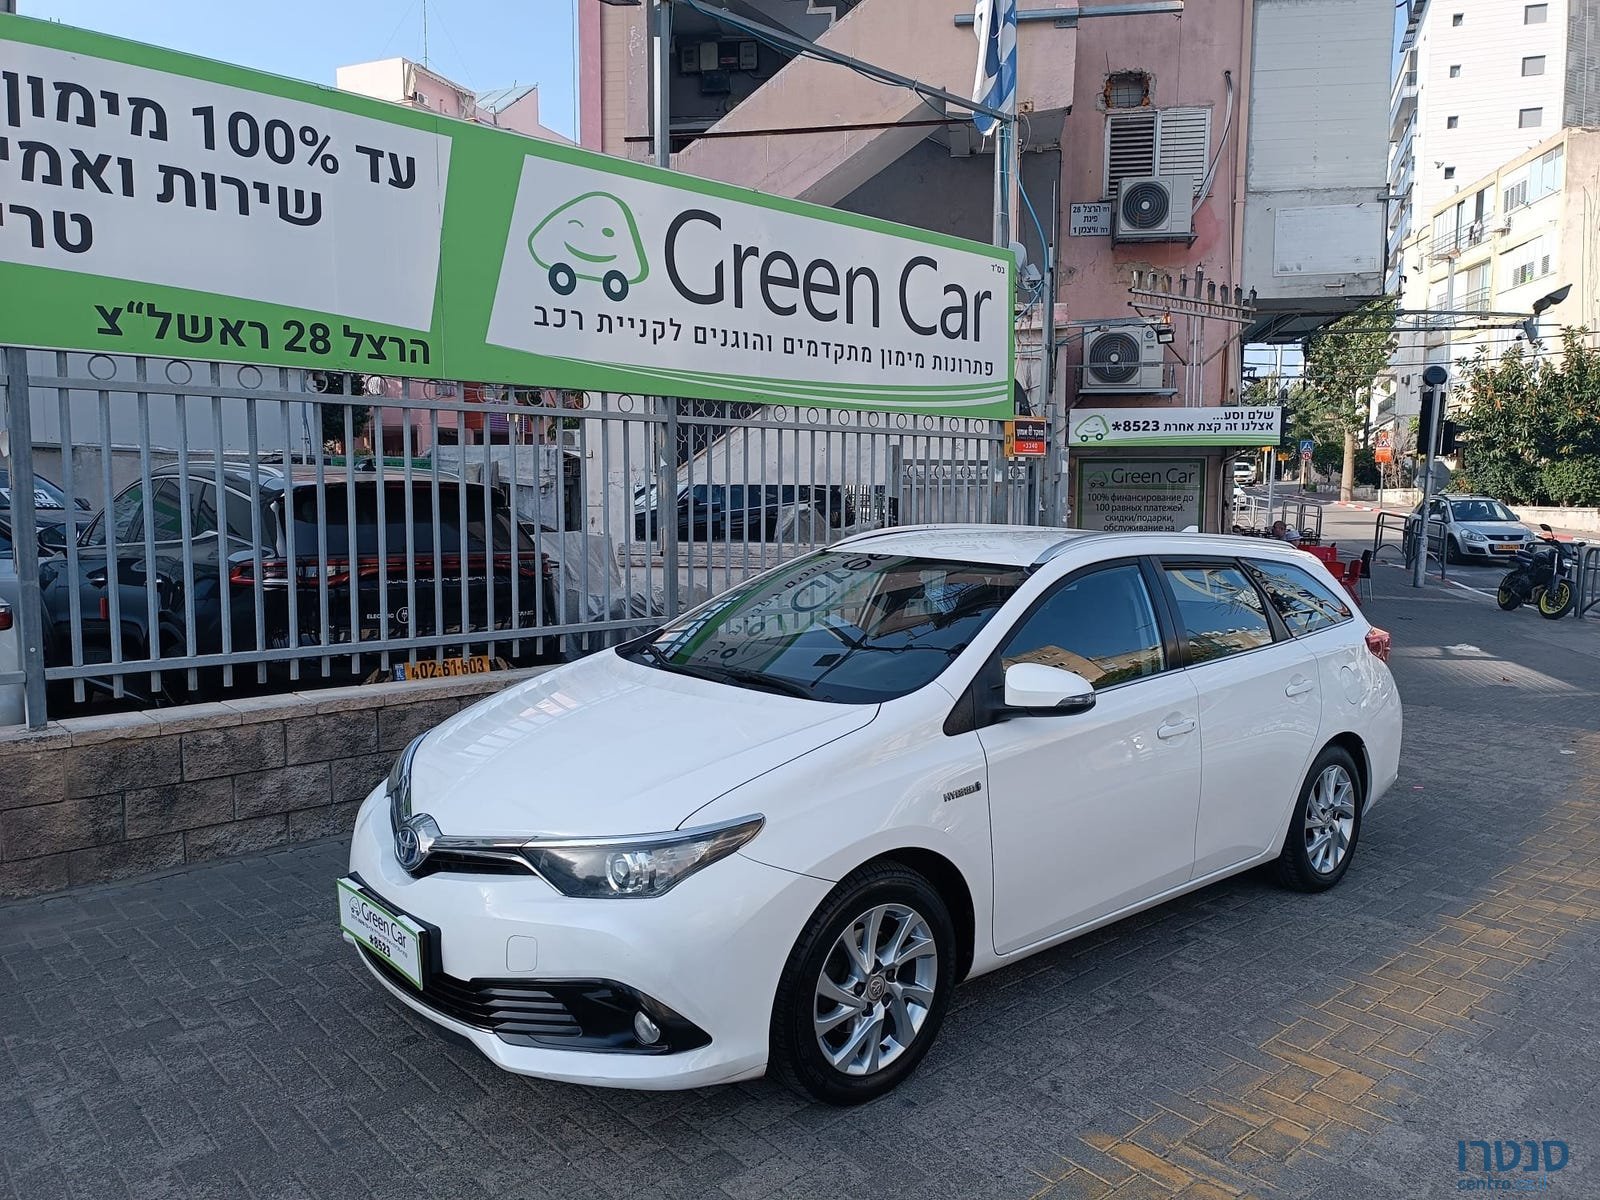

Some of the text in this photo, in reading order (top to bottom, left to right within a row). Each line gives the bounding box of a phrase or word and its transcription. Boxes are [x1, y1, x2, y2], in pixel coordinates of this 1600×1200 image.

[2, 70, 416, 190] עד 100% מימון
[156, 163, 322, 227] שירות
[664, 208, 992, 343] Green Car
[282, 319, 331, 355] 28
[342, 323, 430, 365] הרצל
[534, 305, 994, 376] פתרונות מימון מתקדמים והוגנים לקניית רכב
[1247, 409, 1275, 420] שלם
[1163, 423, 1194, 432] אחרת
[1197, 422, 1222, 433] קצת
[1225, 422, 1238, 431] זה
[1241, 420, 1274, 431] אצלנו
[1111, 467, 1196, 484] Green Car
[1110, 492, 1182, 504] финансирование
[1182, 494, 1194, 503] до
[1095, 503, 1110, 512] 100
[1111, 504, 1142, 513] равных
[1103, 523, 1163, 532] обслуживание
[361, 902, 391, 936] Green
[391, 923, 407, 949] Car
